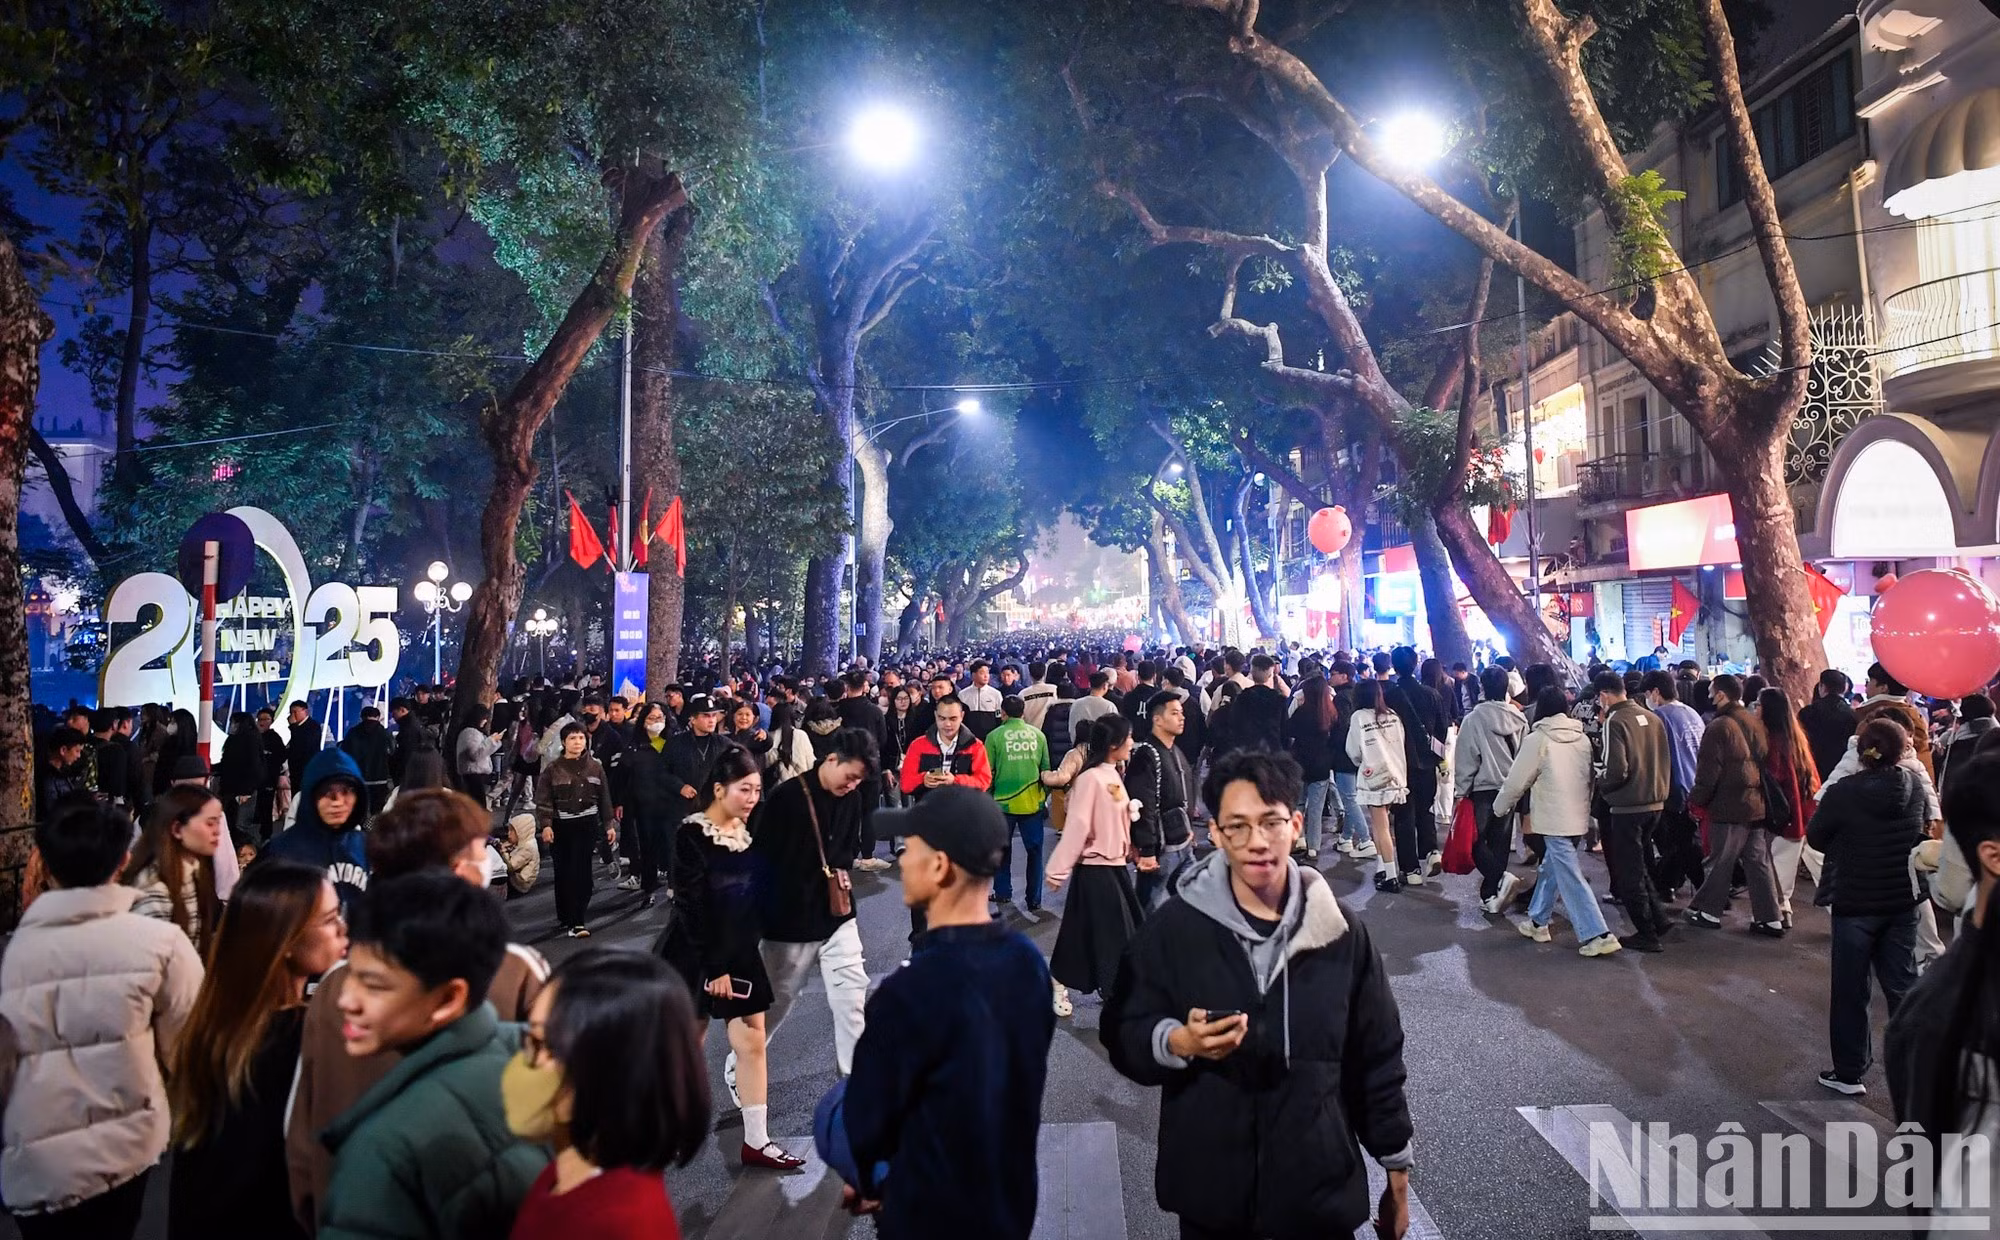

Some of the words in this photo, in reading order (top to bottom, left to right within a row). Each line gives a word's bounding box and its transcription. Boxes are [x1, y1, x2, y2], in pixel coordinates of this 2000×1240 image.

[215, 596, 290, 618] HAPPY
[220, 629, 277, 652] NEW
[217, 661, 281, 683] YEAR
[1004, 728, 1037, 741] Grab
[1006, 740, 1038, 753] Food
